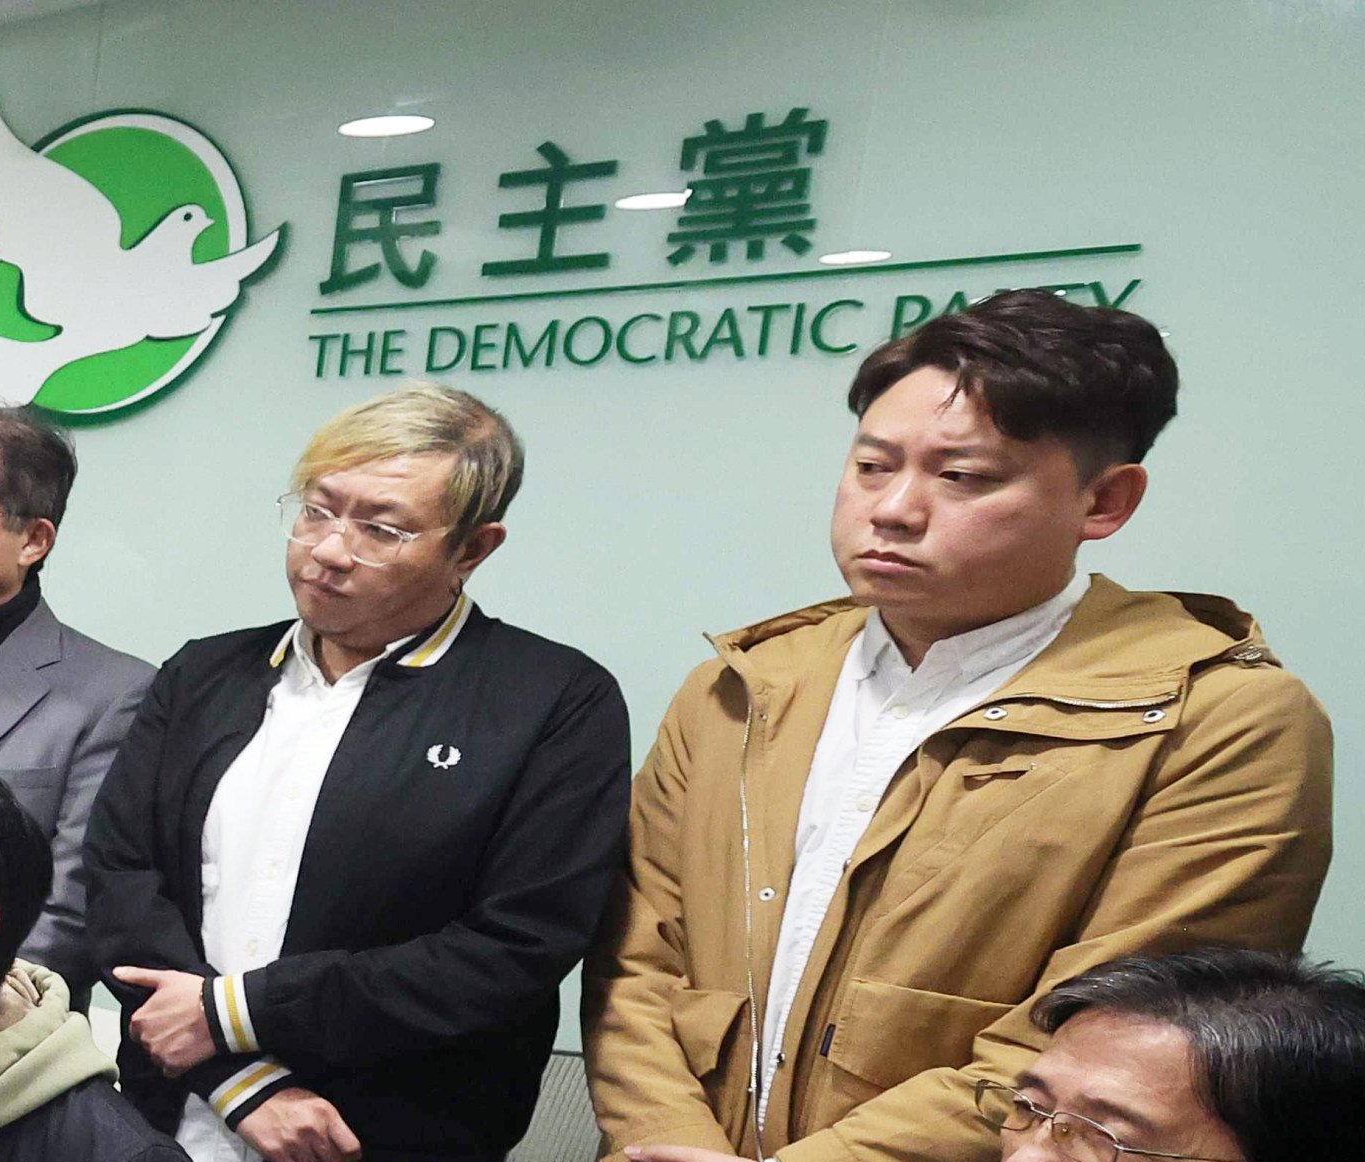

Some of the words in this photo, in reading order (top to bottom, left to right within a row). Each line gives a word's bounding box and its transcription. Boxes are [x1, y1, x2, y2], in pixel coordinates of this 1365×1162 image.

[321, 108, 828, 295] 民主黨
[310, 330, 406, 378] THE
[424, 299, 864, 375] DEMOCRATIC
